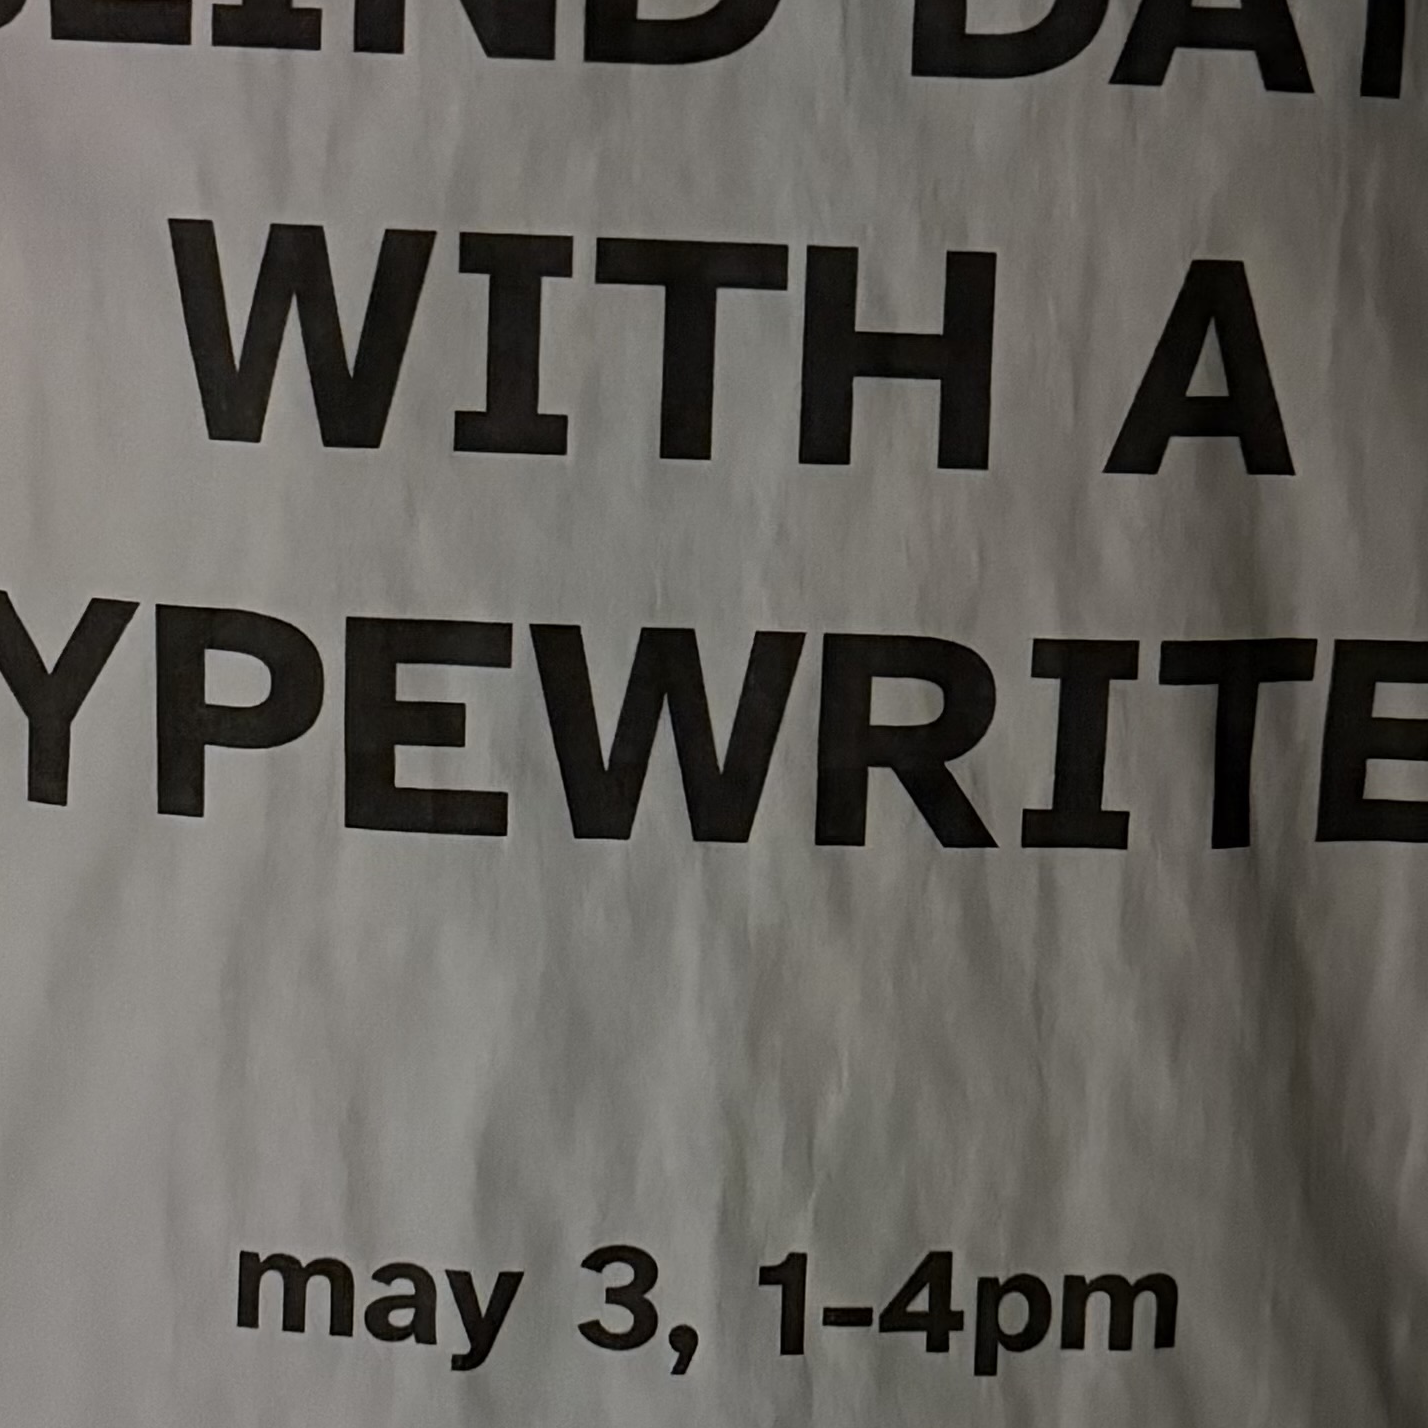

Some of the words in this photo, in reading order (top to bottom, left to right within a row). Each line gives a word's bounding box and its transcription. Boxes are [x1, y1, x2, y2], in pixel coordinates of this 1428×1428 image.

[168, 218, 997, 471] WITH
[1102, 259, 1297, 477] A
[237, 1250, 525, 1372] may
[577, 1244, 699, 1376] 3,
[758, 1250, 1179, 1377] 1-4pm
